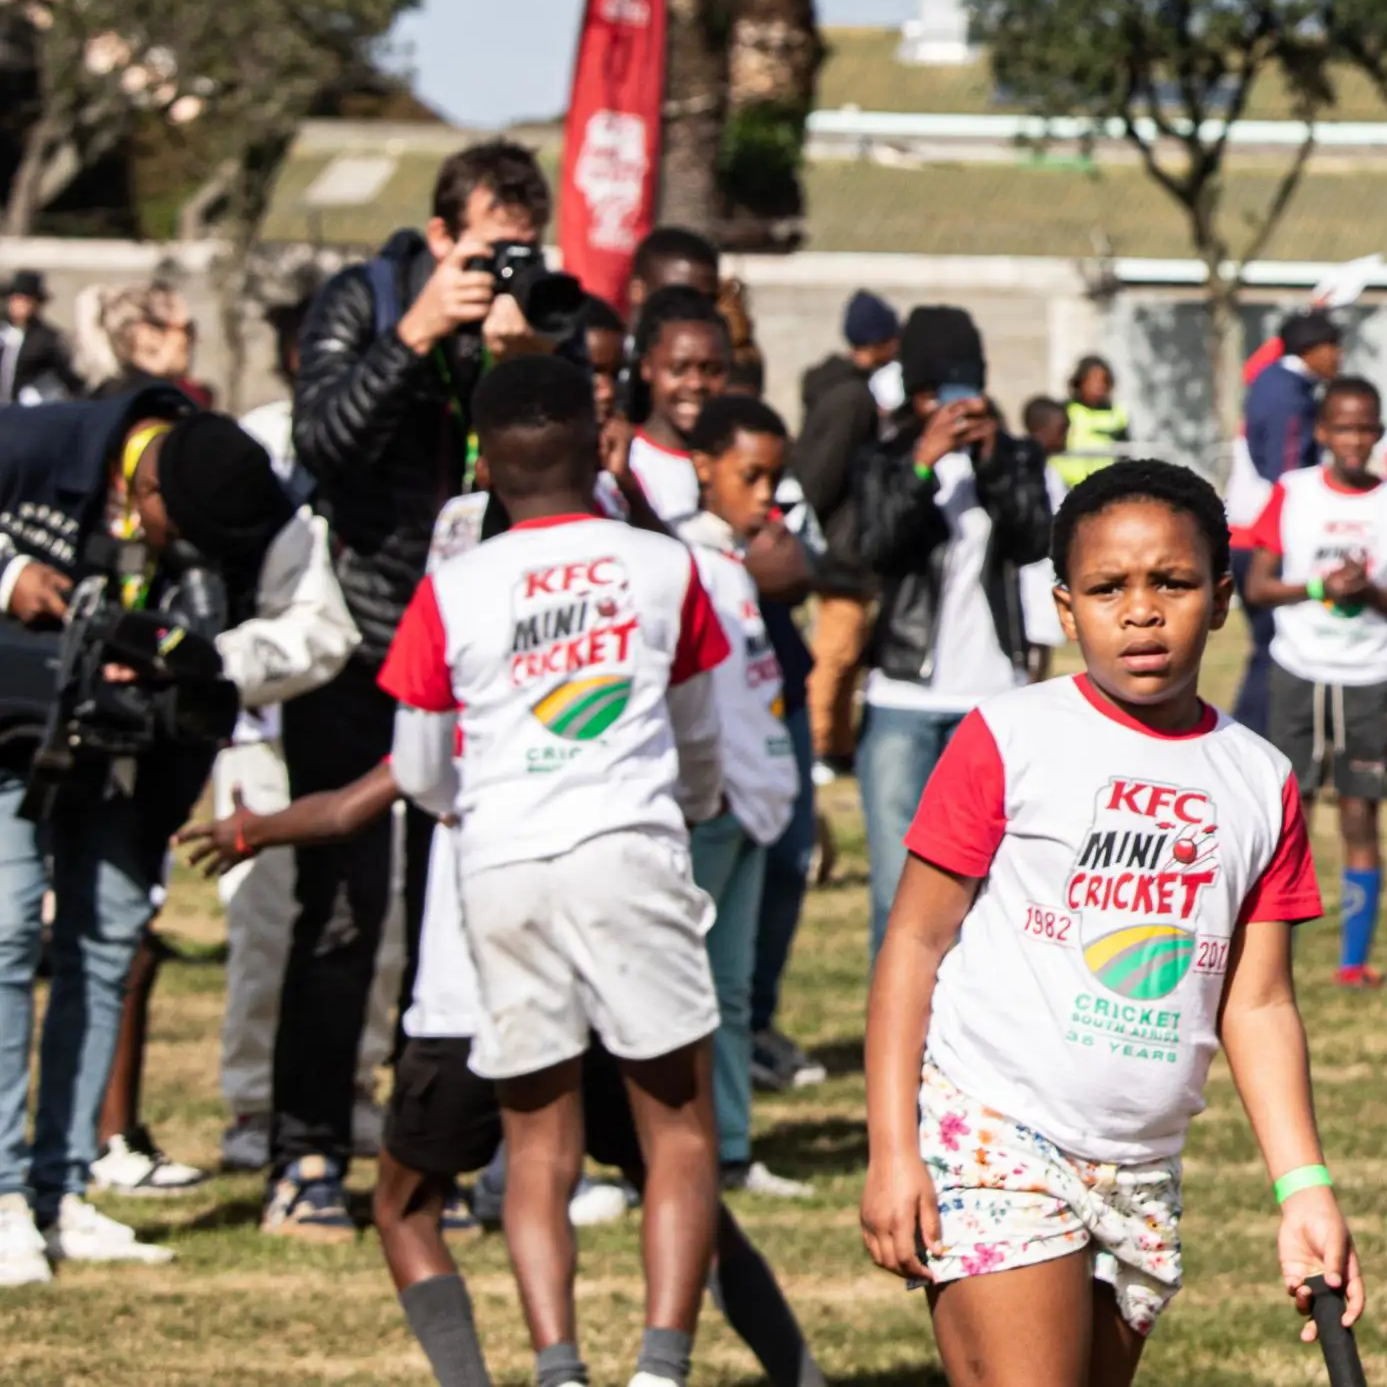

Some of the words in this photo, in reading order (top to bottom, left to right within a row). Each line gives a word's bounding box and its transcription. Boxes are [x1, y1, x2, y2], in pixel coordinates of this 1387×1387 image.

[524, 556, 617, 599] KFC
[512, 601, 588, 652] MINI
[510, 615, 640, 687] CRICKET
[1105, 780, 1208, 824] KFC
[1077, 830, 1169, 870] MINI
[1067, 871, 1216, 919] CRICKET
[1023, 906, 1072, 942] 1982
[1196, 941, 1229, 969] 201
[1074, 993, 1182, 1030] CRICKET
[1109, 1040, 1178, 1064] YEARS
